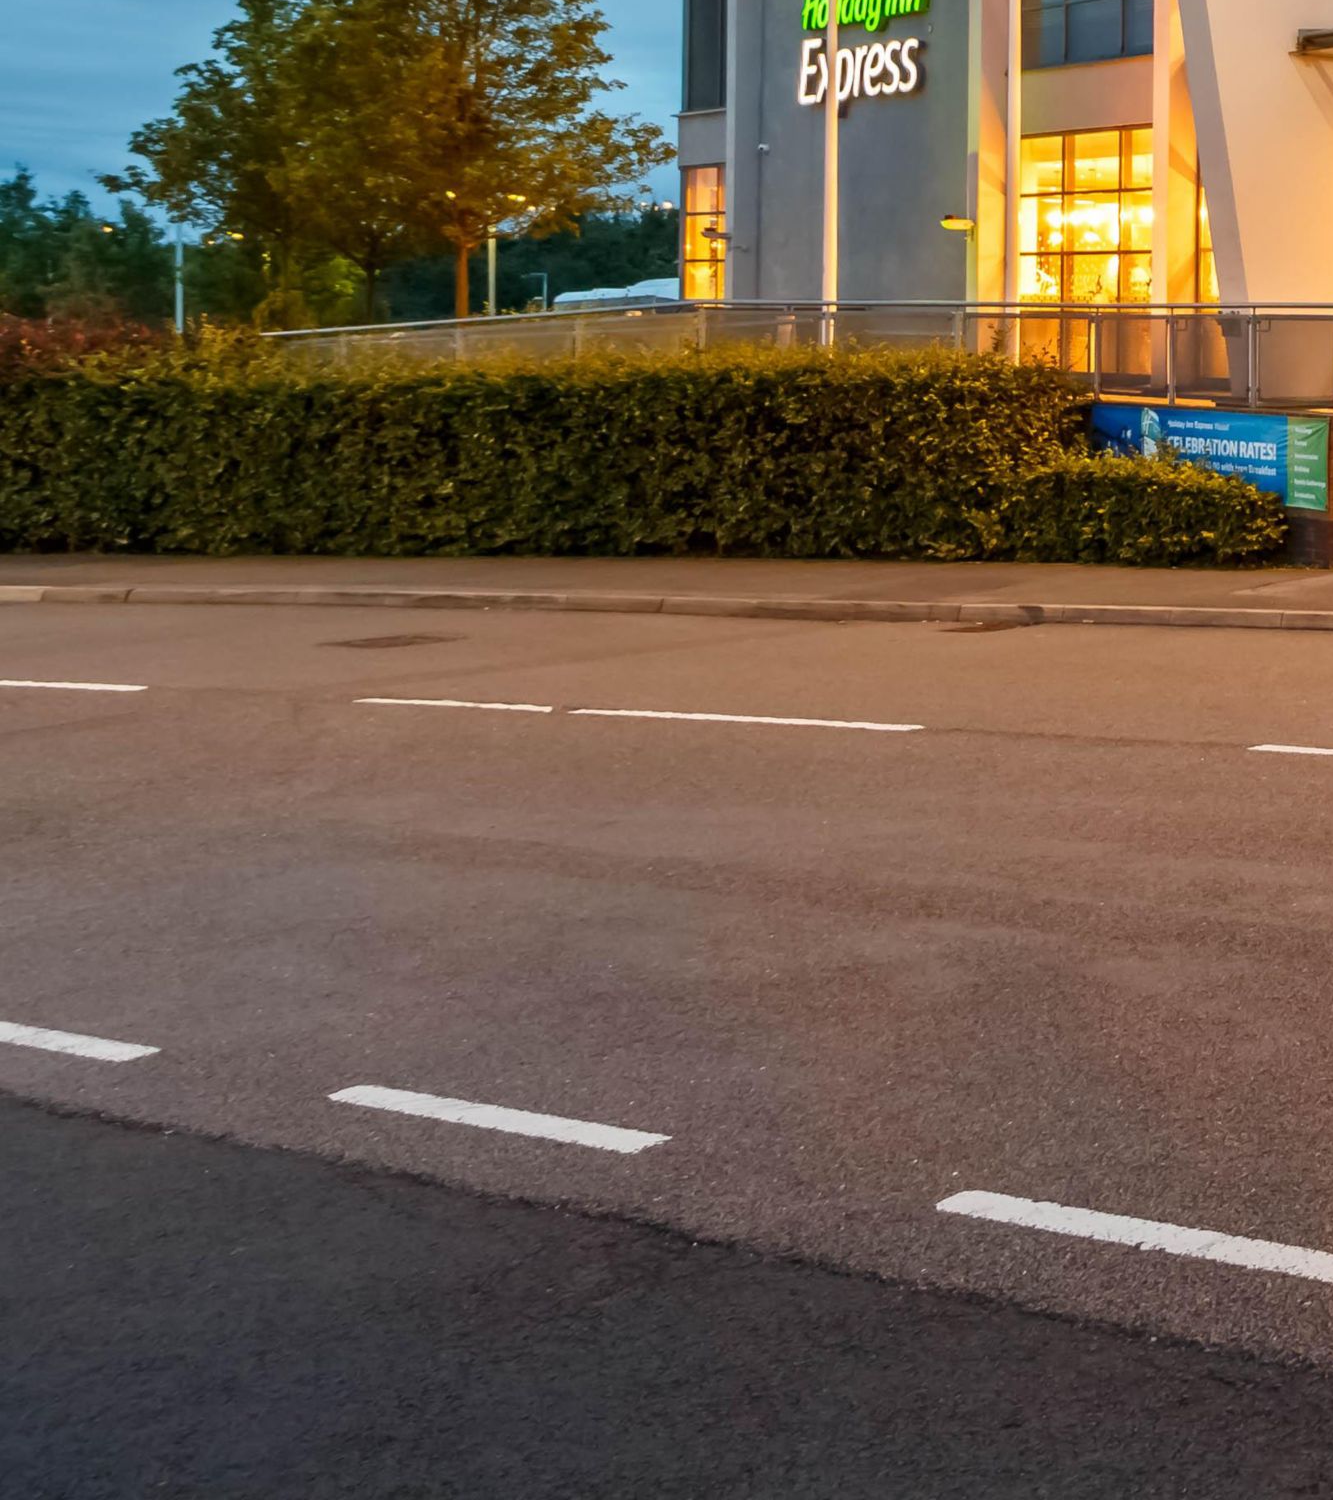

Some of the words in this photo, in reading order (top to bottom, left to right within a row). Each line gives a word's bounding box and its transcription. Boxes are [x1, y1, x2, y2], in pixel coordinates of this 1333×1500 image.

[798, 38, 919, 105] Express
[1167, 435, 1238, 457] CELEBRATION
[1239, 441, 1277, 461] RATES!
